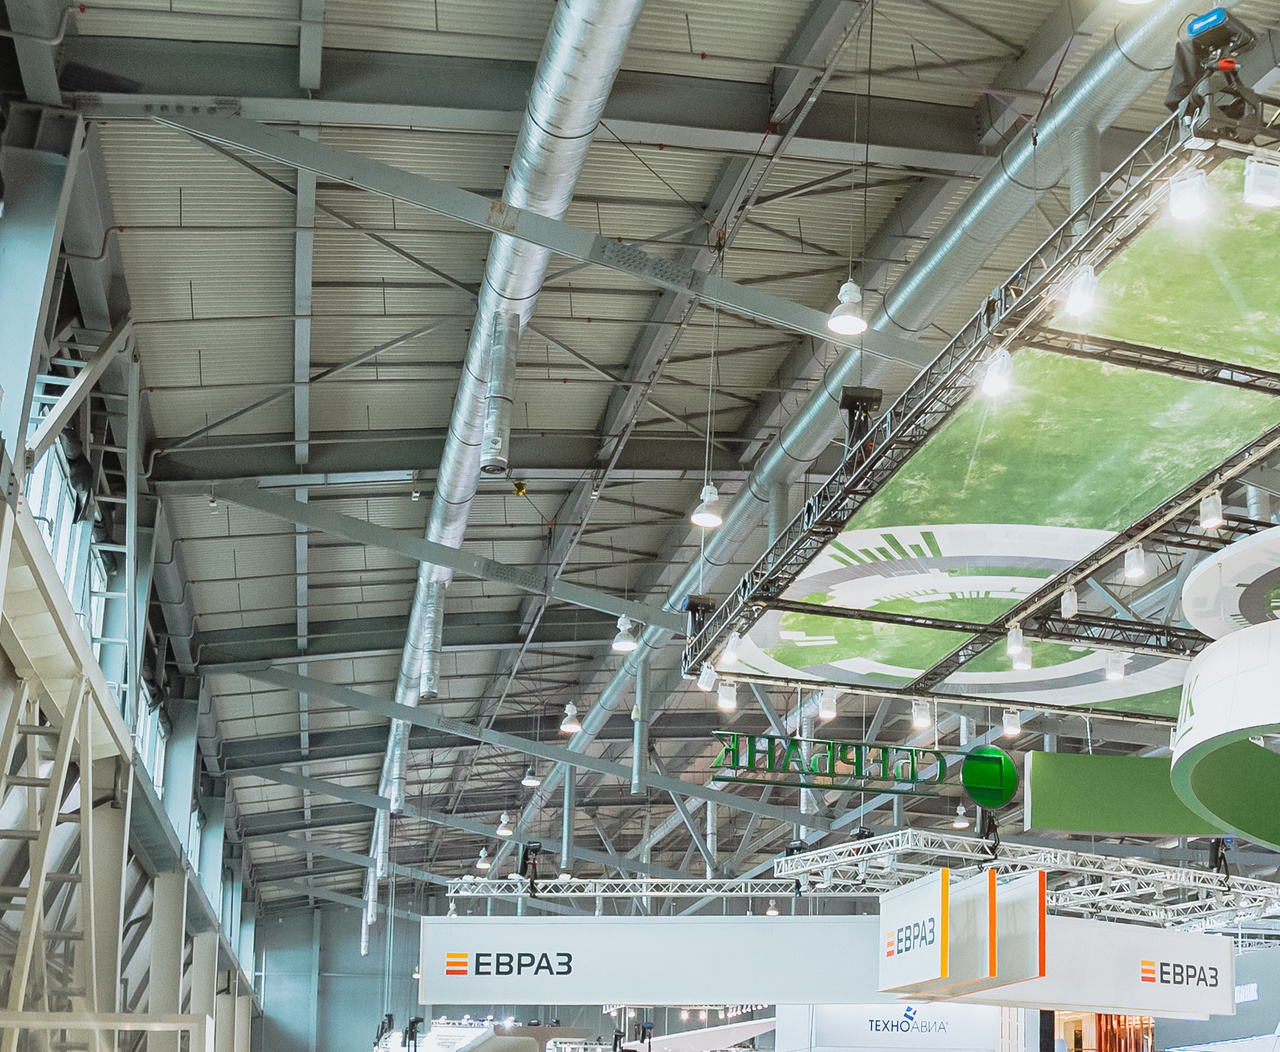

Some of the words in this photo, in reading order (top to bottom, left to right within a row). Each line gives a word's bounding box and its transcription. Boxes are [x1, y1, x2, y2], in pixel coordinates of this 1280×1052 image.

[896, 917, 936, 955] ЕВРАЗ
[474, 952, 573, 976] ЕВРАЗ
[1159, 961, 1219, 988] ЕВРАЗ
